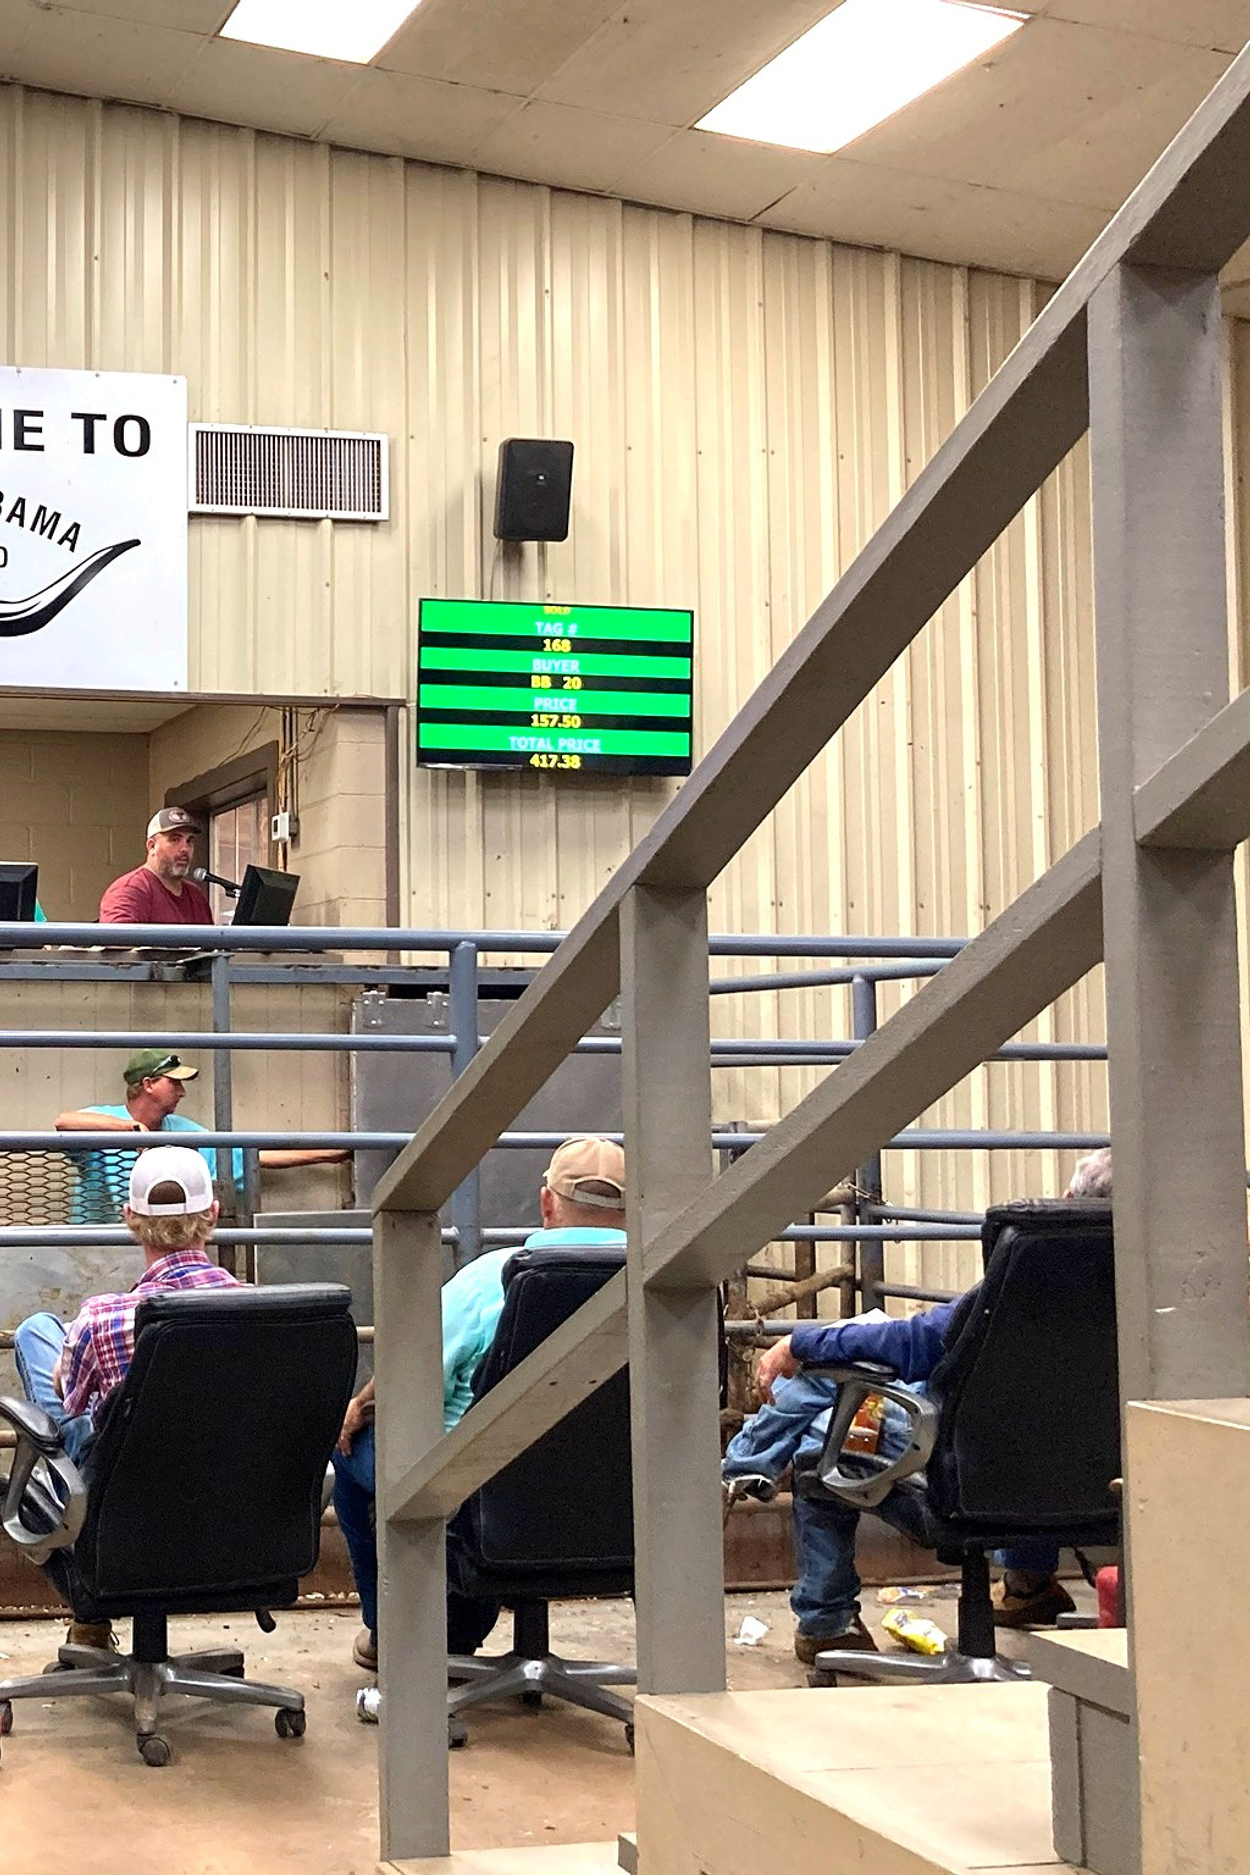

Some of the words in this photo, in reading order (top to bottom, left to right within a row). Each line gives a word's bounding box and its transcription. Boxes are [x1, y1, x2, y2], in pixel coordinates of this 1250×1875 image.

[70, 411, 152, 458] TO
[535, 621, 563, 635] TAG
[567, 622, 579, 635] #
[543, 638, 572, 653] 168
[532, 658, 580, 673] BUYER
[530, 674, 552, 689] BB
[562, 676, 583, 690] 20
[533, 697, 578, 711] PRICE
[530, 714, 582, 729] 157.50
[509, 736, 554, 751] TOTAL
[558, 738, 602, 752] PRICE
[529, 753, 581, 769] 417.38
